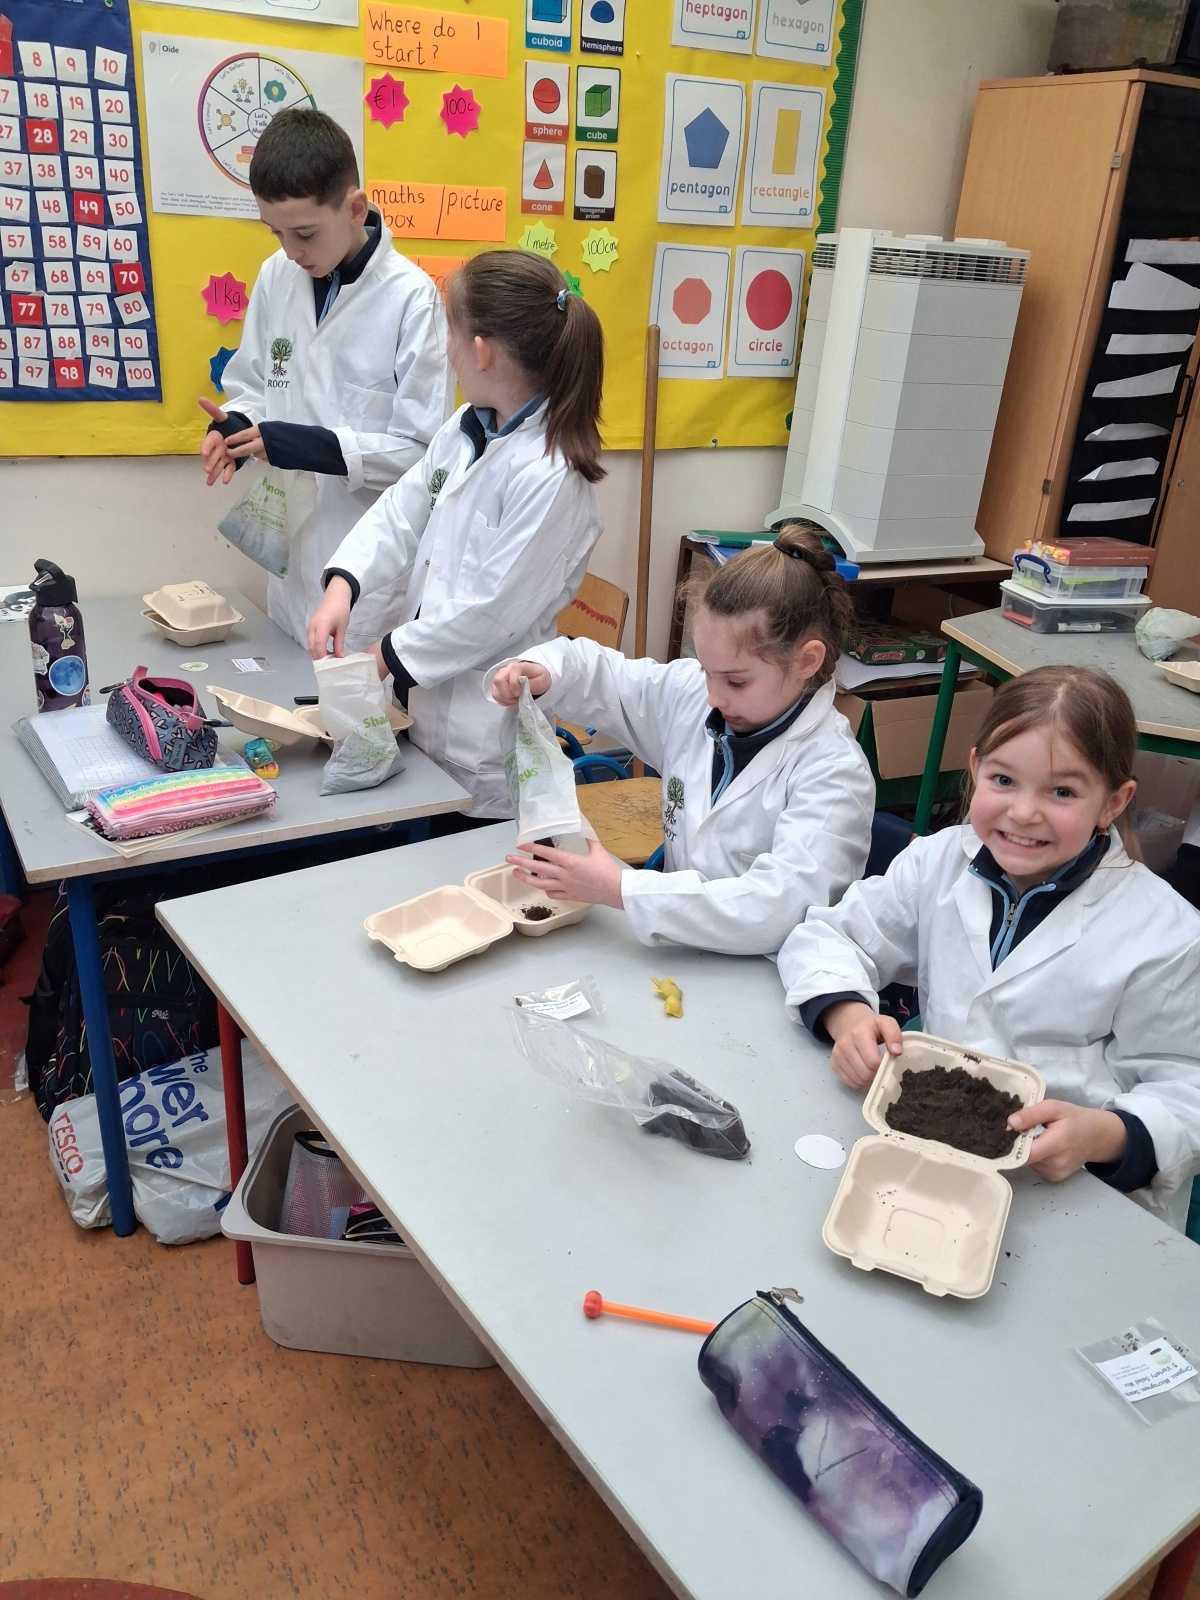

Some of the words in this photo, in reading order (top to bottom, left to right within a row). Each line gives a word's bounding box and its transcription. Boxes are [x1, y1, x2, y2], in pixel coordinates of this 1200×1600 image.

[686, 0, 748, 22] heptagon
[368, 7, 421, 35] Where
[434, 16, 456, 38] do
[772, 13, 824, 34] hexagon
[531, 36, 562, 48] cuboid
[582, 41, 623, 53] hemisphere
[32, 52, 42, 67] 8
[66, 57, 76, 72] 9
[102, 58, 118, 75] 10
[1, 89, 9, 103] 7
[33, 93, 49, 108] 18
[69, 96, 84, 110] 19
[105, 99, 124, 114] 20
[33, 129, 53, 144] 28
[70, 130, 88, 144] 29
[533, 126, 562, 136] sphere
[586, 131, 608, 140] cube
[109, 133, 128, 148] 30
[4, 161, 23, 176] 37
[37, 163, 57, 177] 38
[75, 165, 93, 179] 39
[109, 168, 129, 183] 40
[372, 184, 425, 204] maths
[670, 180, 730, 198] pentagon
[753, 185, 809, 201] rectangle
[4, 196, 23, 211] 47
[42, 199, 61, 213] 48
[79, 200, 99, 216] 49
[115, 201, 135, 216] 50
[531, 203, 553, 212] cone
[383, 208, 416, 228] box
[7, 234, 25, 248] 57
[48, 235, 67, 249] 58
[82, 236, 101, 250] 59
[113, 238, 132, 252] 60
[11, 270, 29, 283] 67
[50, 270, 69, 284] 68
[86, 270, 105, 284] 69
[119, 271, 139, 285] 70
[18, 302, 37, 316] 77
[52, 303, 70, 317] 78
[86, 303, 105, 316] 79
[123, 300, 142, 315] 80
[24, 336, 41, 349] 87
[58, 336, 76, 349] 88
[91, 335, 110, 348] 89
[124, 336, 144, 350] 90
[662, 338, 714, 354] octagon
[749, 338, 783, 352] circle
[25, 365, 43, 379] 97
[59, 366, 79, 380] 98
[95, 365, 113, 379] 99
[128, 367, 152, 380] 100
[267, 379, 290, 388] ROOT
[53, 1112, 84, 1175] TESCO
